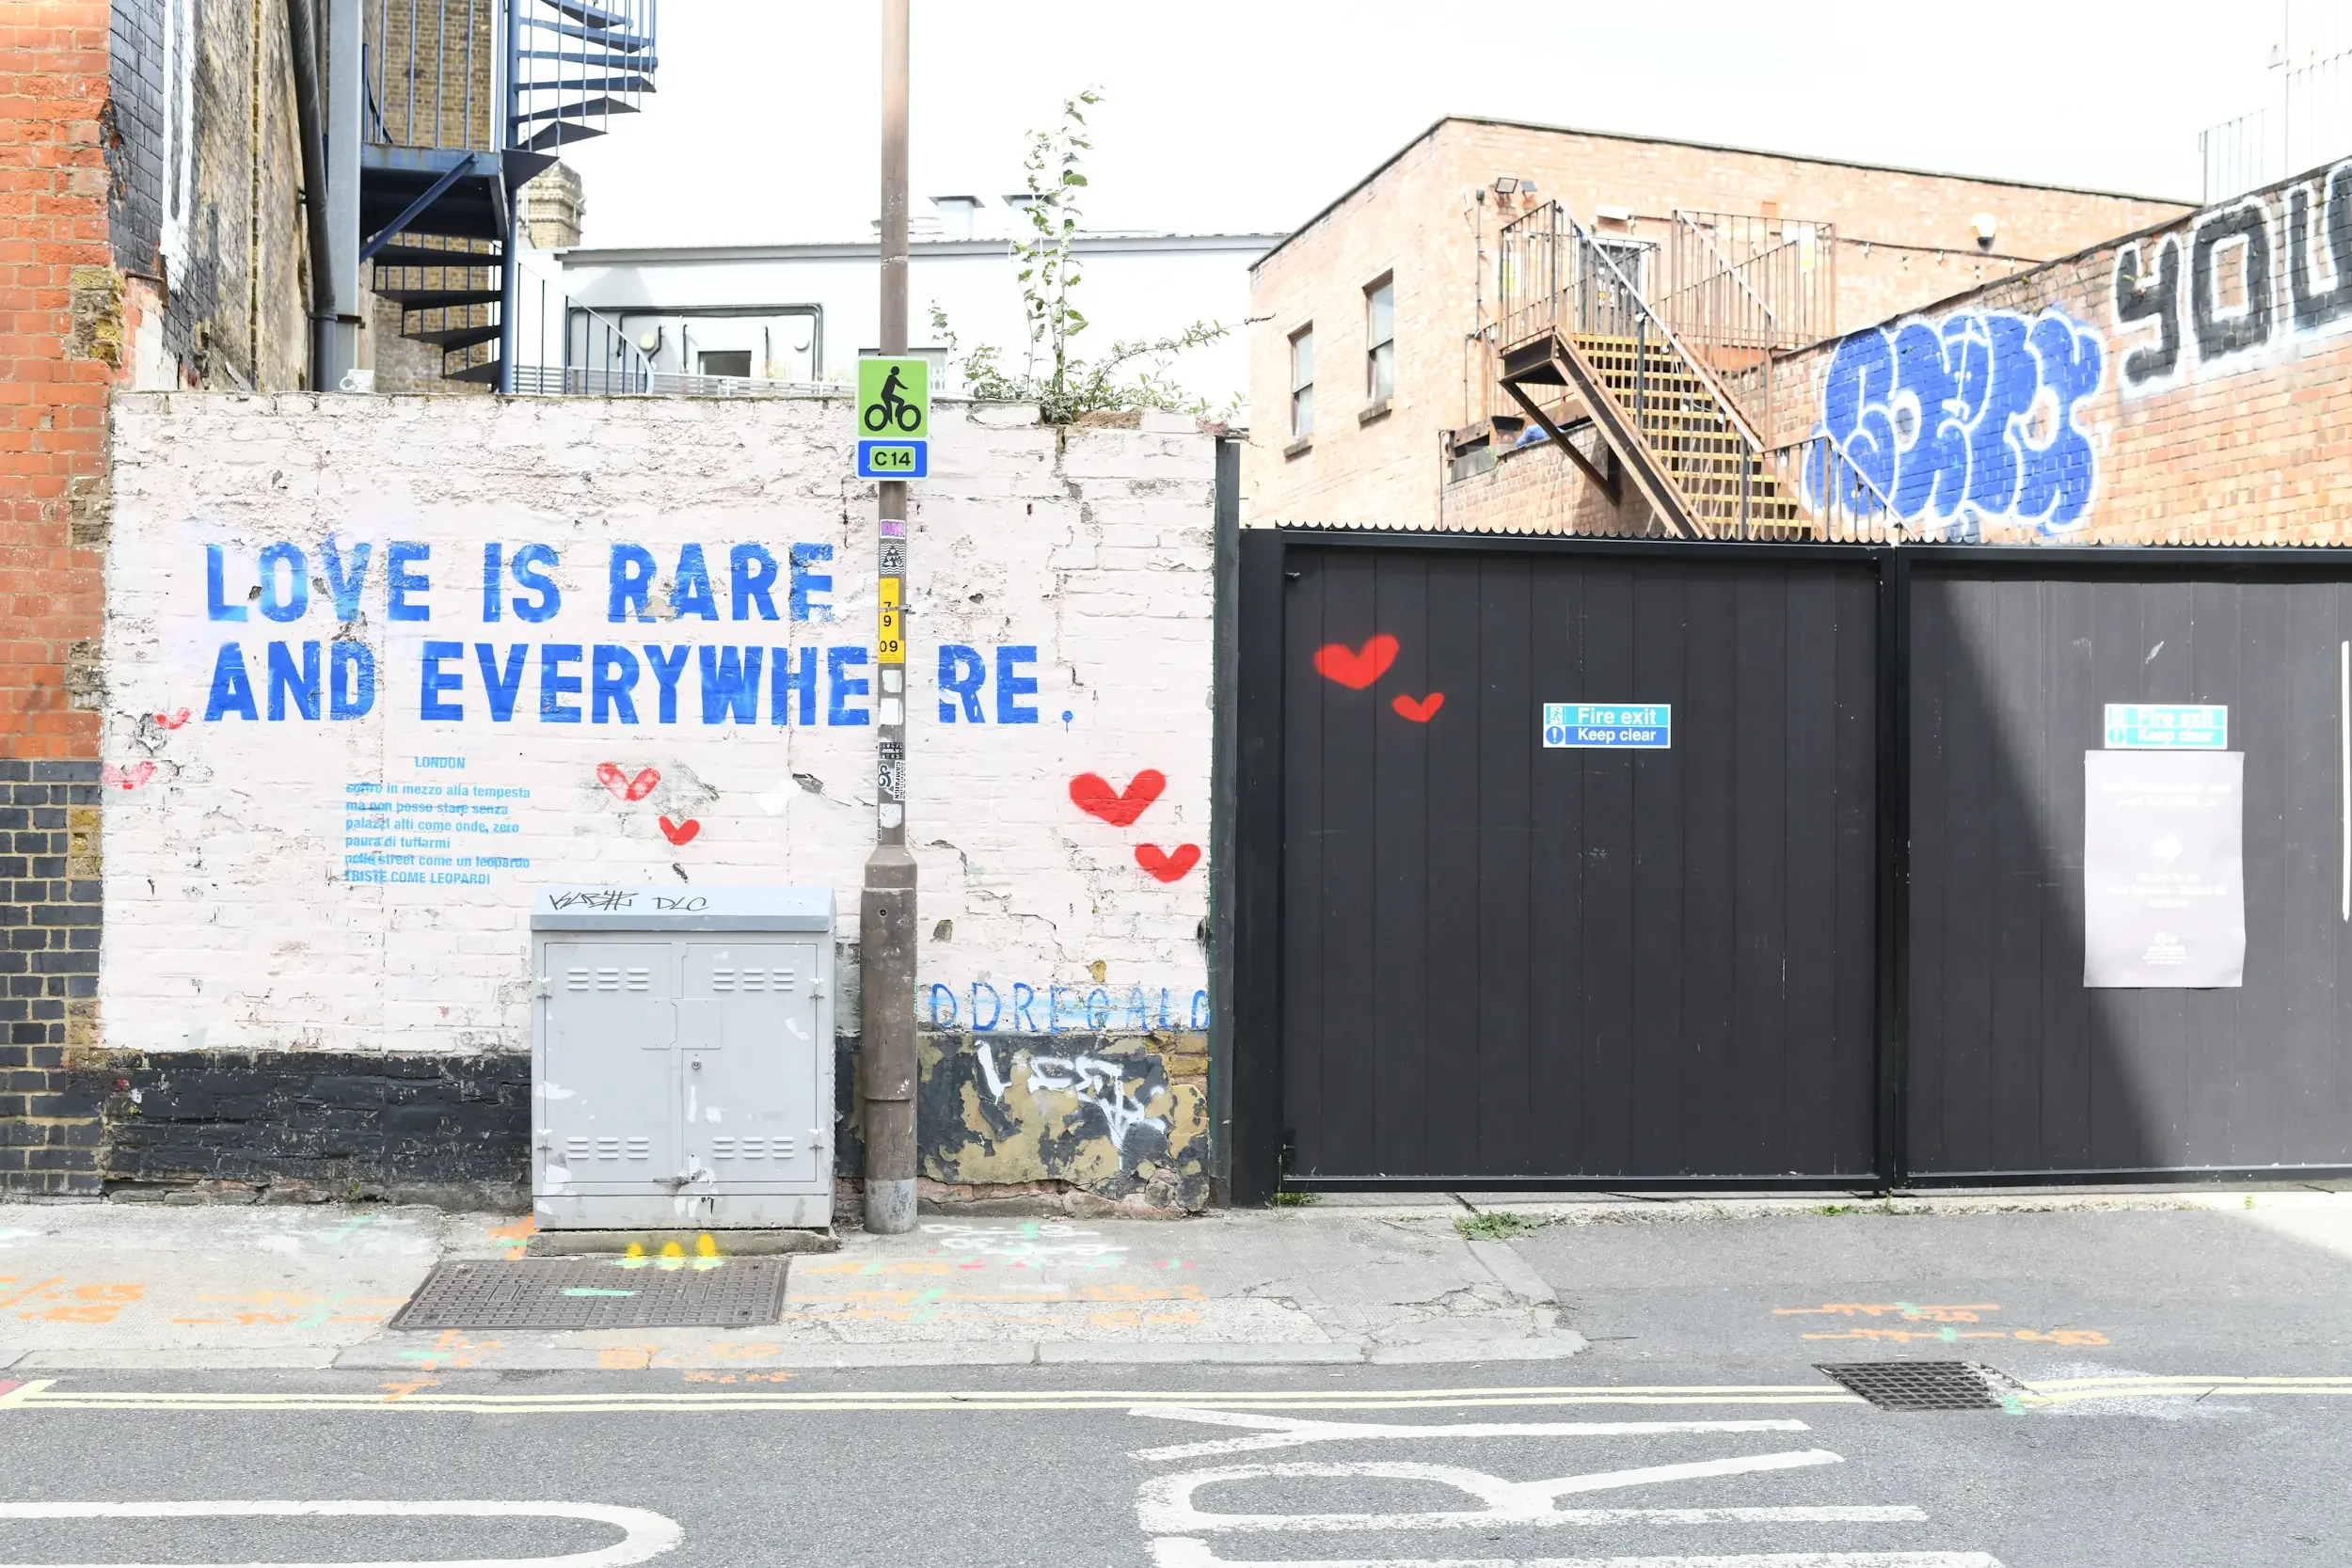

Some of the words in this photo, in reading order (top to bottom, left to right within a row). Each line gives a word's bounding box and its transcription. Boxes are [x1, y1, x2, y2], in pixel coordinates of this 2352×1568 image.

[206, 532, 431, 623] LOVE
[483, 542, 560, 623] IS
[607, 542, 834, 623] RARE
[883, 615, 892, 627] 9
[203, 641, 376, 722] AND
[1578, 706, 1615, 724] Fire
[1620, 708, 1657, 724] exit
[1578, 727, 1615, 743] Keep
[1619, 728, 1657, 741] clear
[414, 756, 466, 769] LONDON
[387, 783, 397, 795] in
[402, 786, 441, 796] mezzo
[446, 784, 469, 797] alla
[473, 785, 531, 800] tempesta
[345, 801, 365, 812] ma
[396, 804, 433, 816] posso
[437, 803, 468, 815] stare
[471, 806, 509, 816] senza
[345, 816, 390, 832] palazzi
[394, 818, 413, 831] alti
[418, 820, 452, 831] come
[455, 819, 489, 834] onde,
[493, 822, 519, 833] zero
[345, 837, 380, 848] paura
[384, 836, 396, 847] di
[400, 837, 452, 849] tuffarmi
[378, 853, 415, 865] street
[419, 857, 453, 866] come
[456, 858, 472, 867] un
[475, 855, 531, 869] leopardo
[344, 870, 388, 883] TRISTE
[390, 871, 426, 884] COME
[430, 873, 490, 885] LEOPARDI
